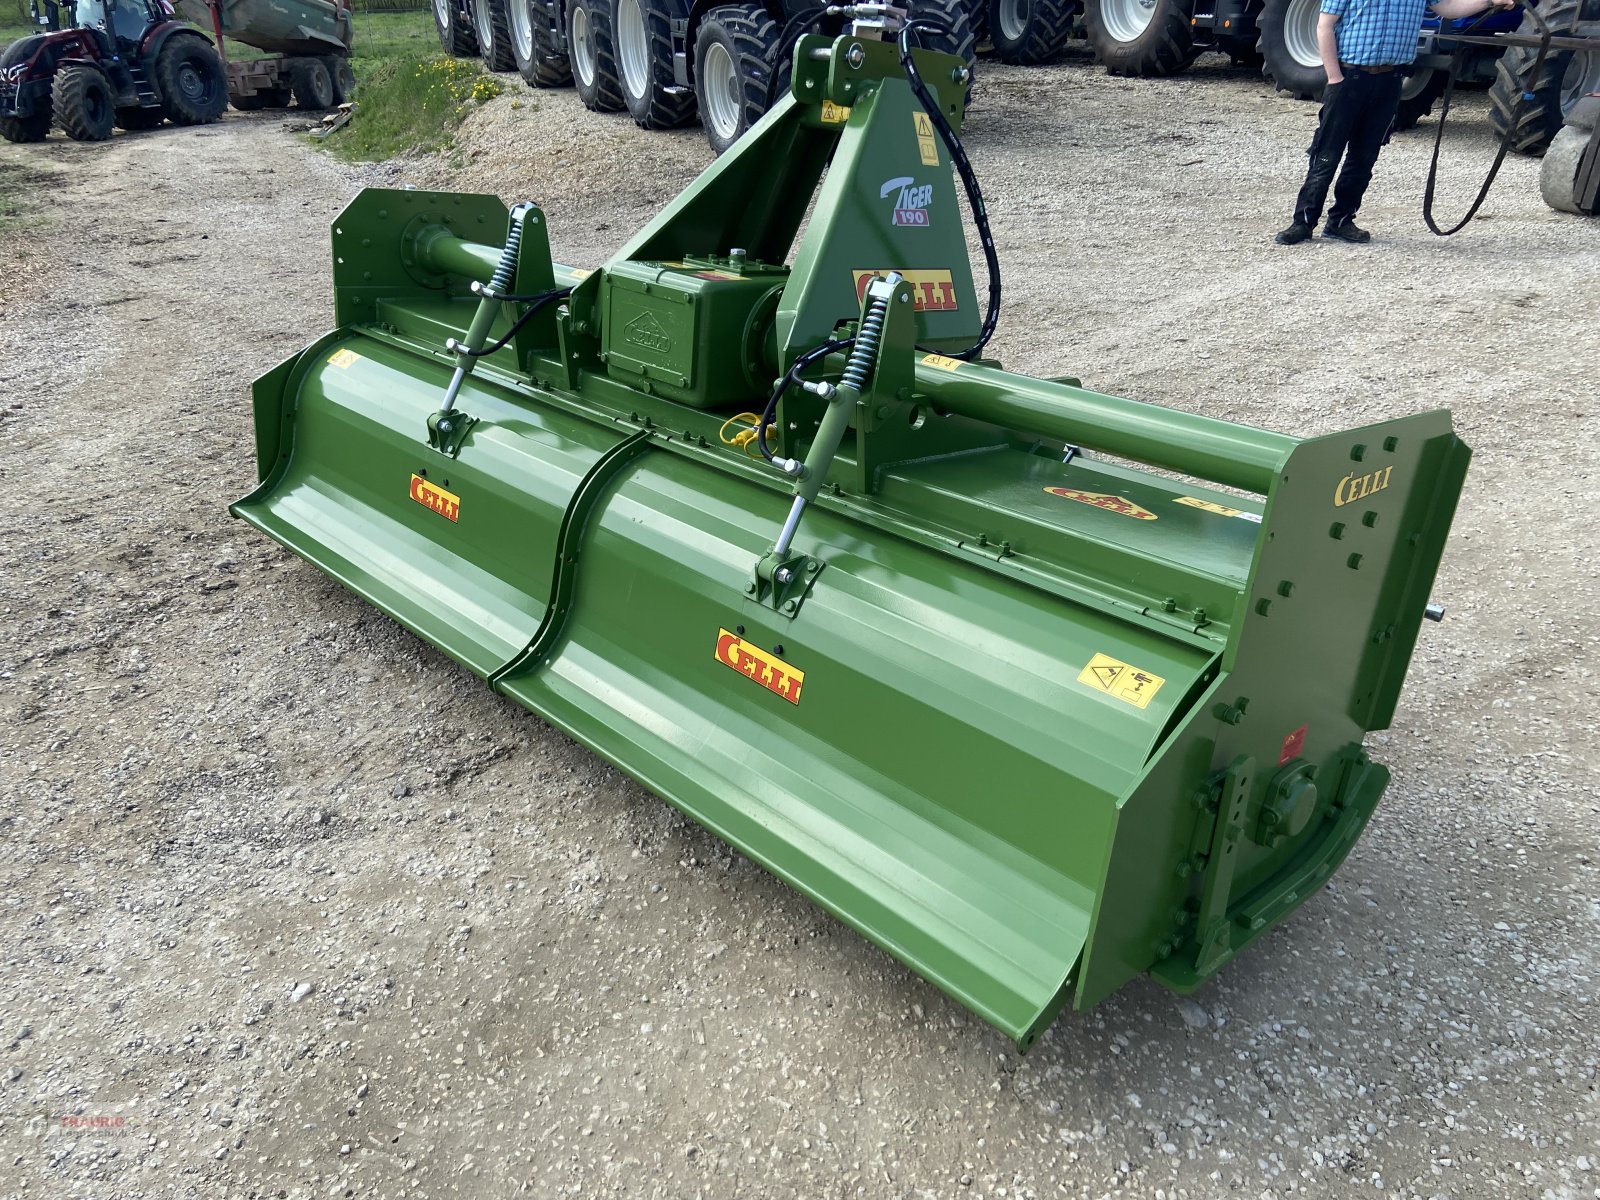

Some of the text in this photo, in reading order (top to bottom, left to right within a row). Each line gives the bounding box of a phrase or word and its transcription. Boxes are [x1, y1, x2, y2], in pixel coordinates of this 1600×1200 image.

[880, 176, 933, 225] TIGER
[900, 211, 924, 223] 190
[411, 477, 458, 522] CELLI
[1335, 466, 1393, 507] CELLI
[717, 634, 802, 704] CELLI
